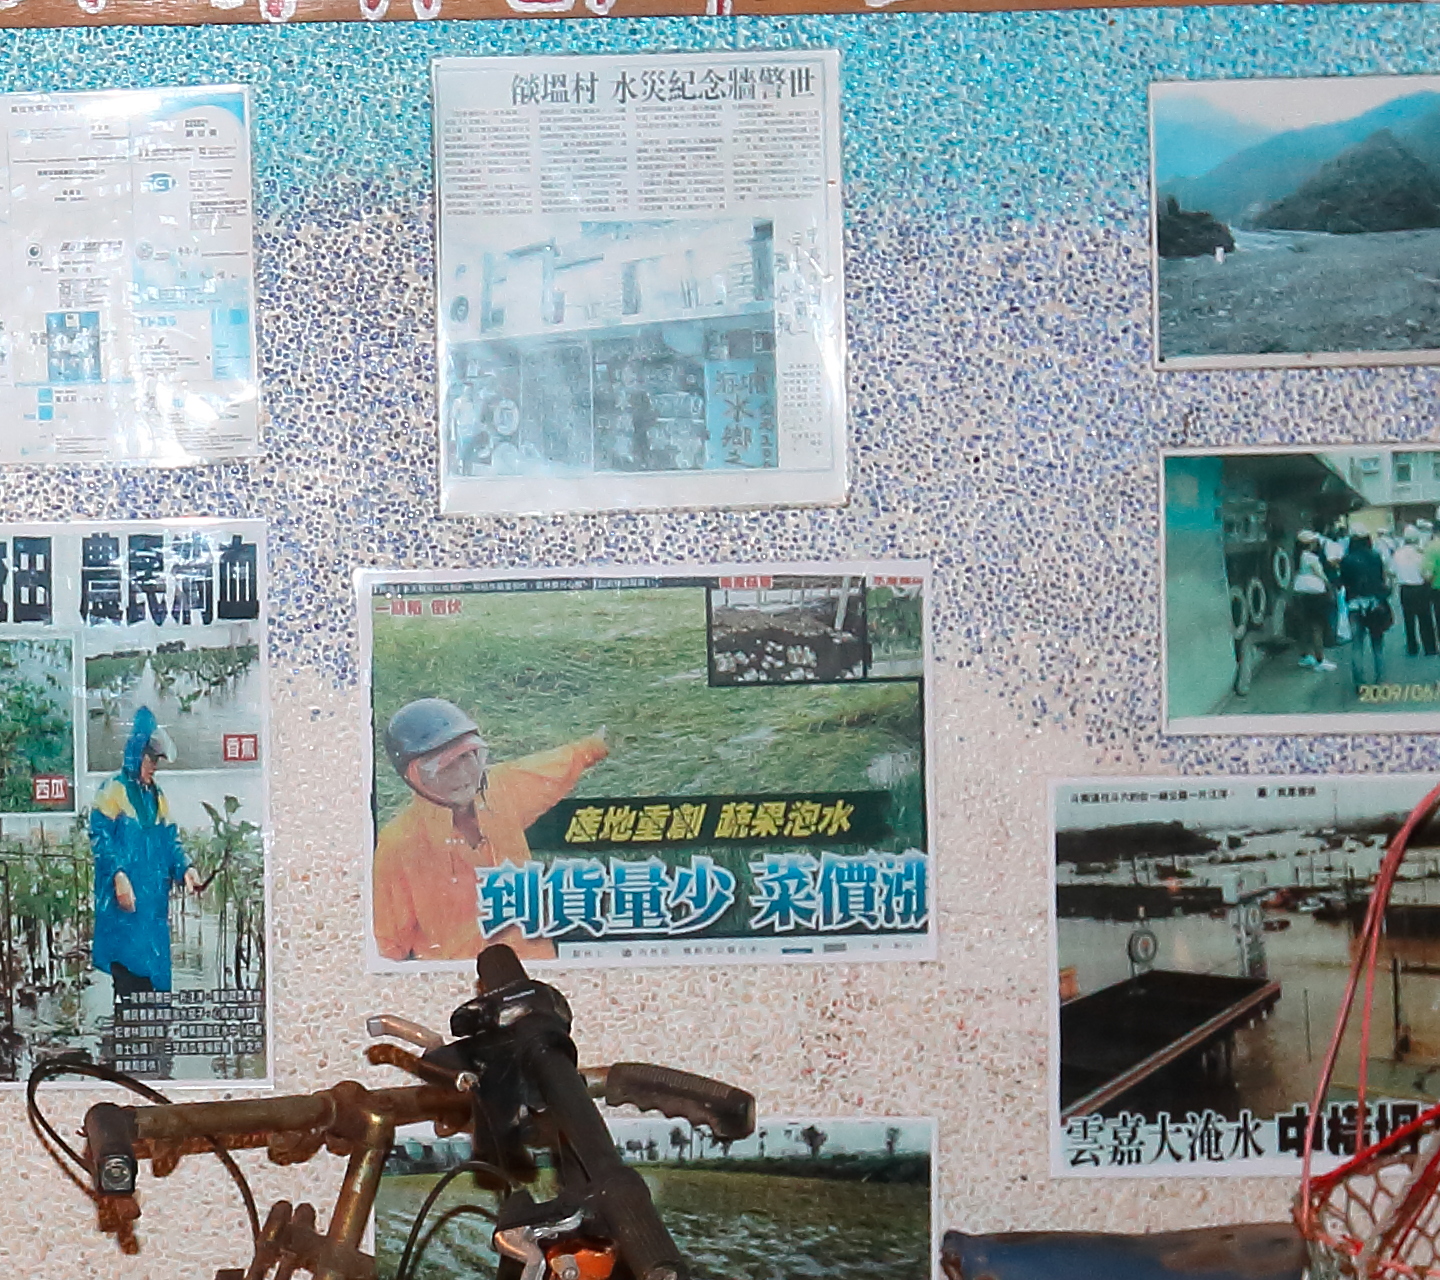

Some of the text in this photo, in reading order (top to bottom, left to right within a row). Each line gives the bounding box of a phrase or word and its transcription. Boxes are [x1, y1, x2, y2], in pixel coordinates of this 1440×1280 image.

[34, 777, 68, 801] 西瓜
[474, 855, 735, 940] 到貨量少
[1067, 1110, 1265, 1167] 雲嘉大淹水
